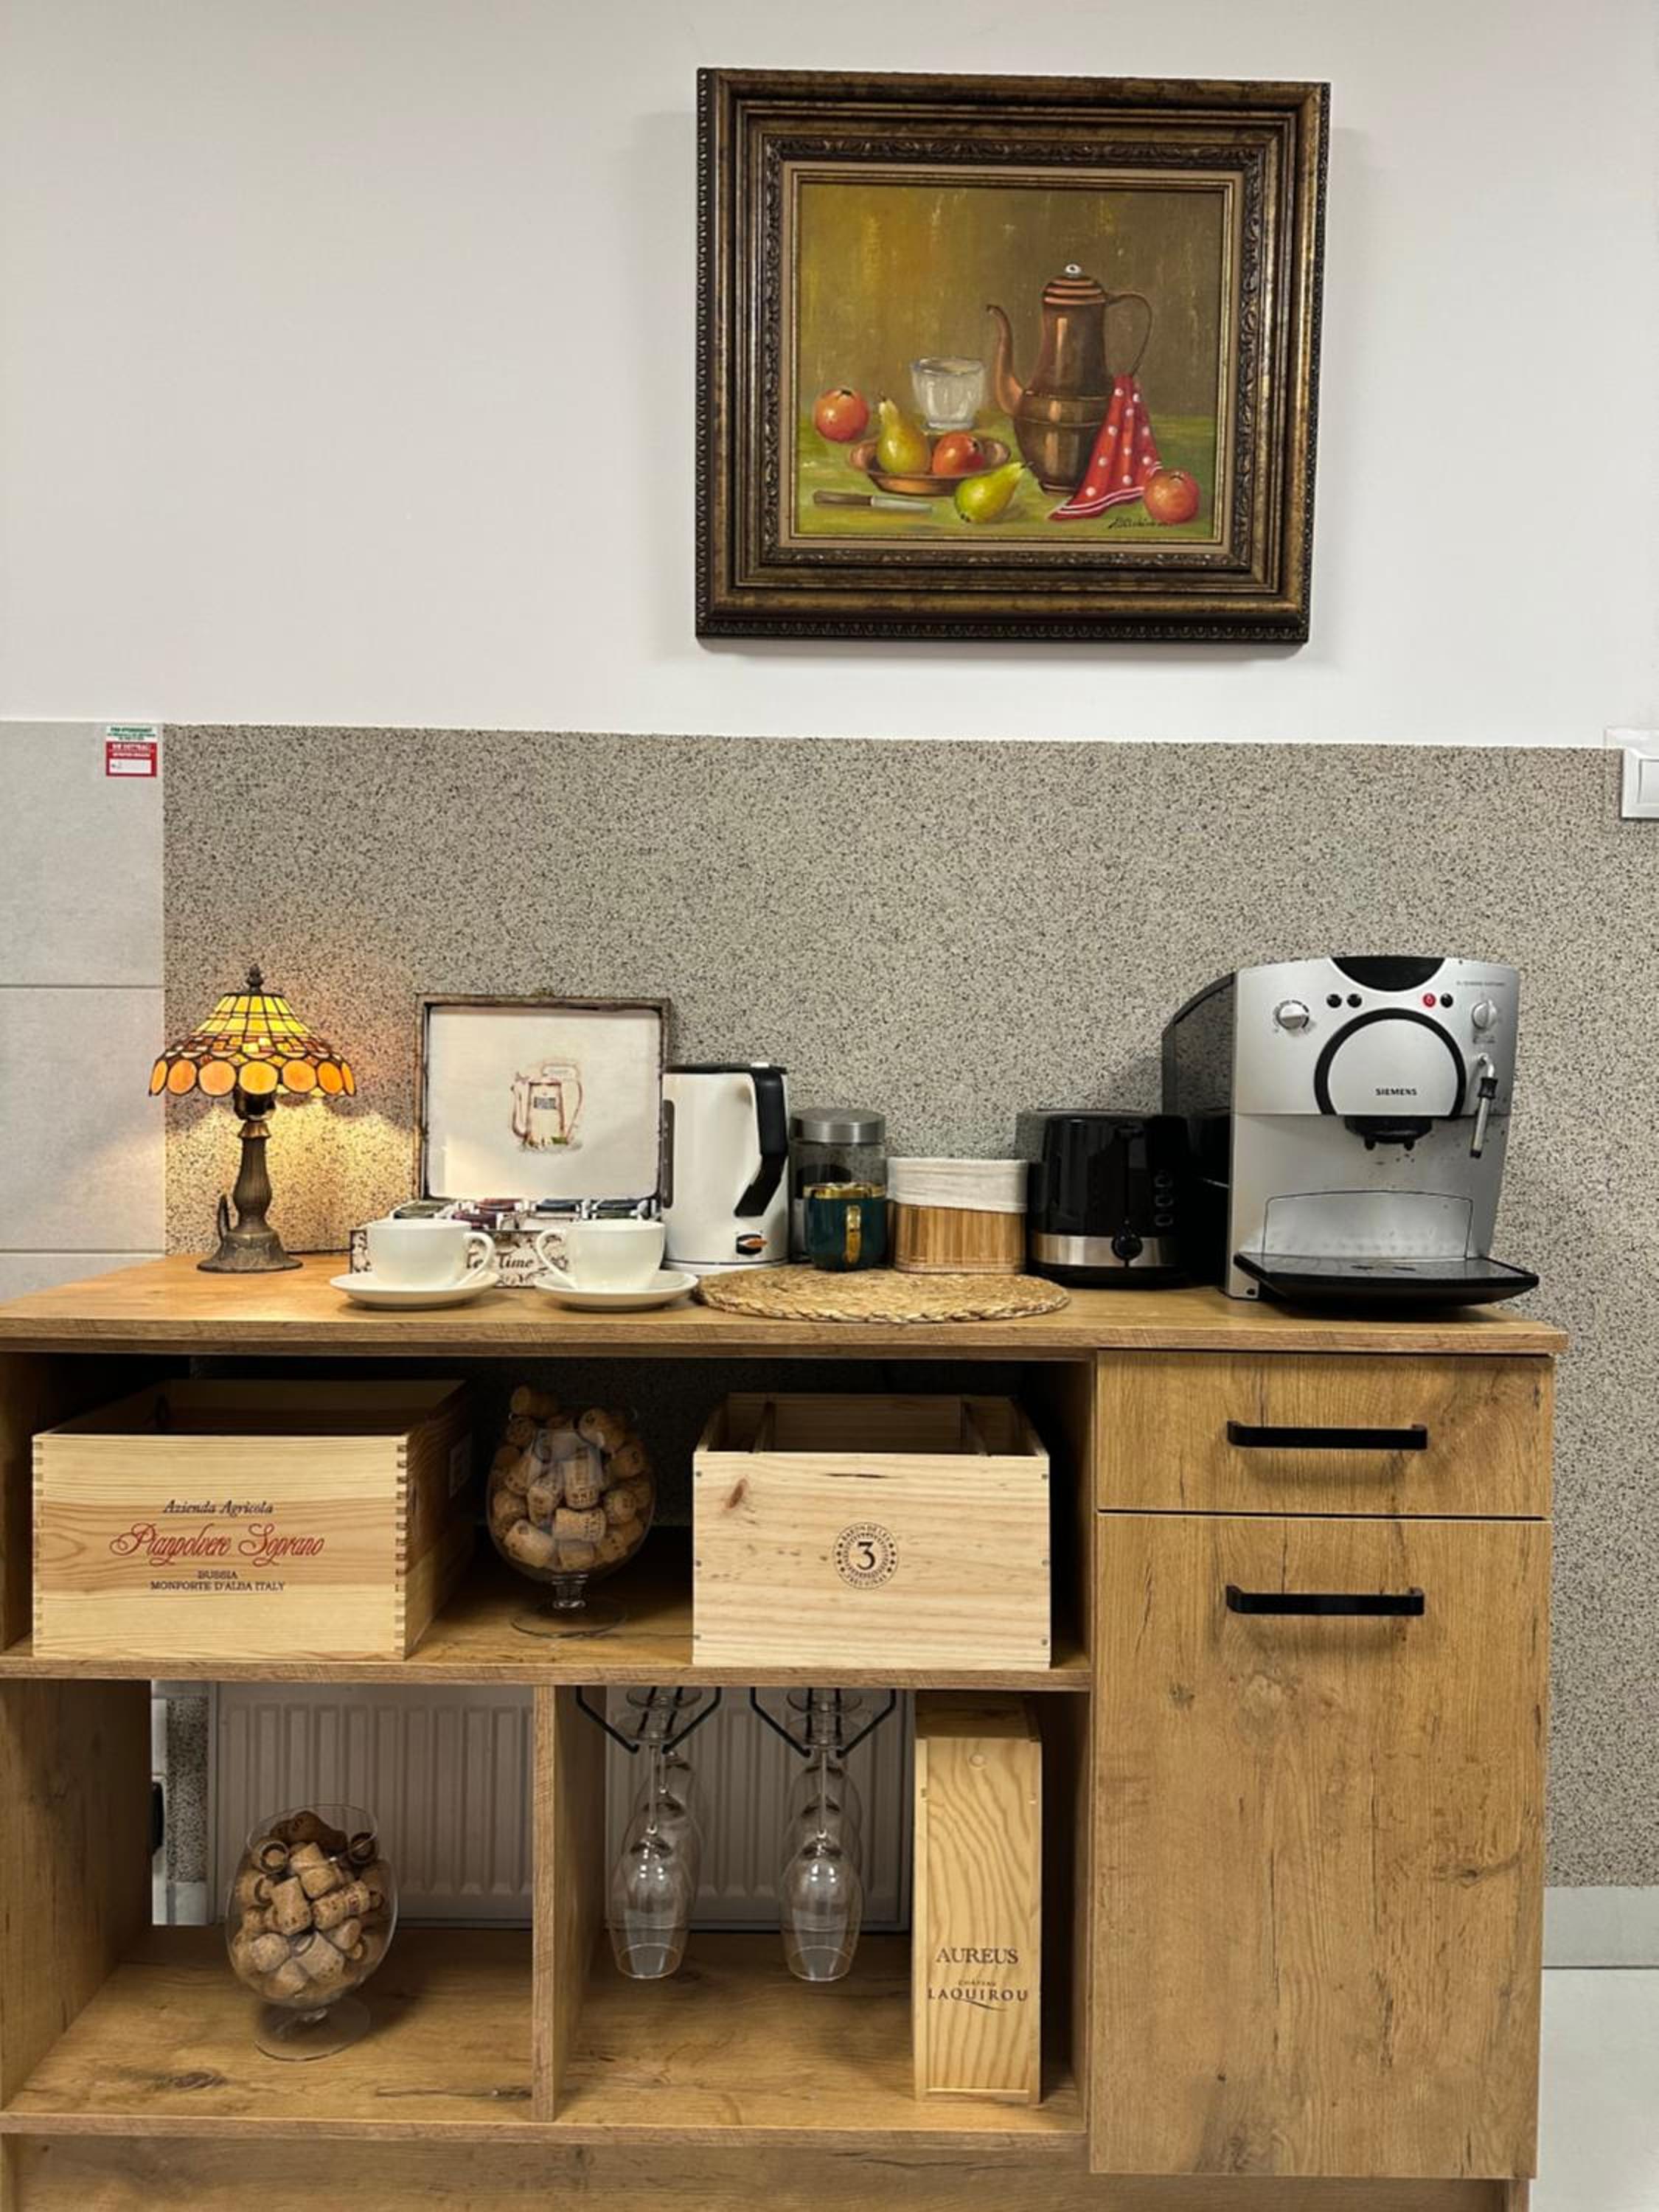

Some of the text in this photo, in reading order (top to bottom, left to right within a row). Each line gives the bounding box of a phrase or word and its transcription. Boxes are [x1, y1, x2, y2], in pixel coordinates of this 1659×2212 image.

[1375, 1088, 1417, 1096] SIEMENS
[495, 1251, 534, 1268] Time
[164, 1500, 273, 1516] Azienda Agricola
[237, 1523, 325, 1567] Soprano
[858, 1541, 875, 1571] 3
[255, 1582, 285, 1590] ITALY
[936, 1947, 1019, 1964] AUREUS
[928, 1989, 1028, 2008] LAQUIROU
